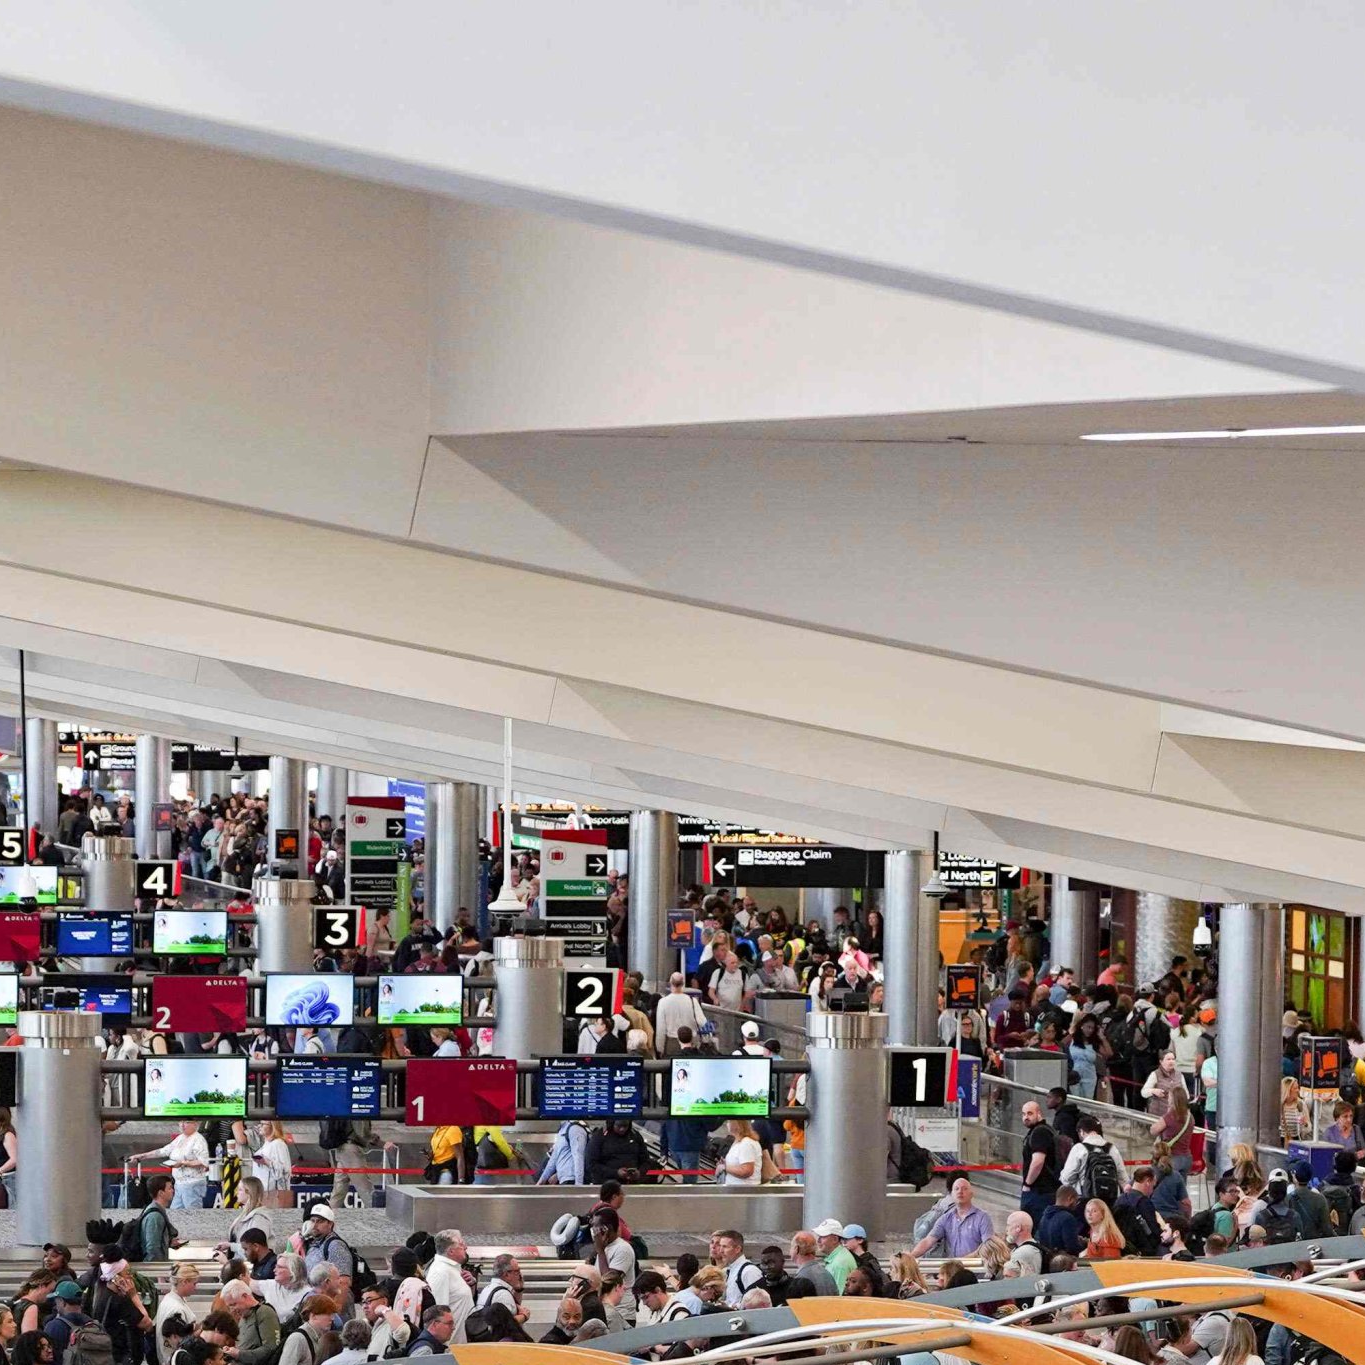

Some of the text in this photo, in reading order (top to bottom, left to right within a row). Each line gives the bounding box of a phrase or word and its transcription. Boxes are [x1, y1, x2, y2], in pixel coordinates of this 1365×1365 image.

[1, 832, 22, 858] 5
[755, 849, 832, 861] Baggage Claim
[142, 871, 168, 894] 4
[951, 870, 980, 881] North
[325, 913, 349, 946] 3
[576, 977, 602, 1015] 2
[156, 1007, 171, 1029] 2
[912, 1058, 927, 1102] 1
[411, 1097, 425, 1122] 1
